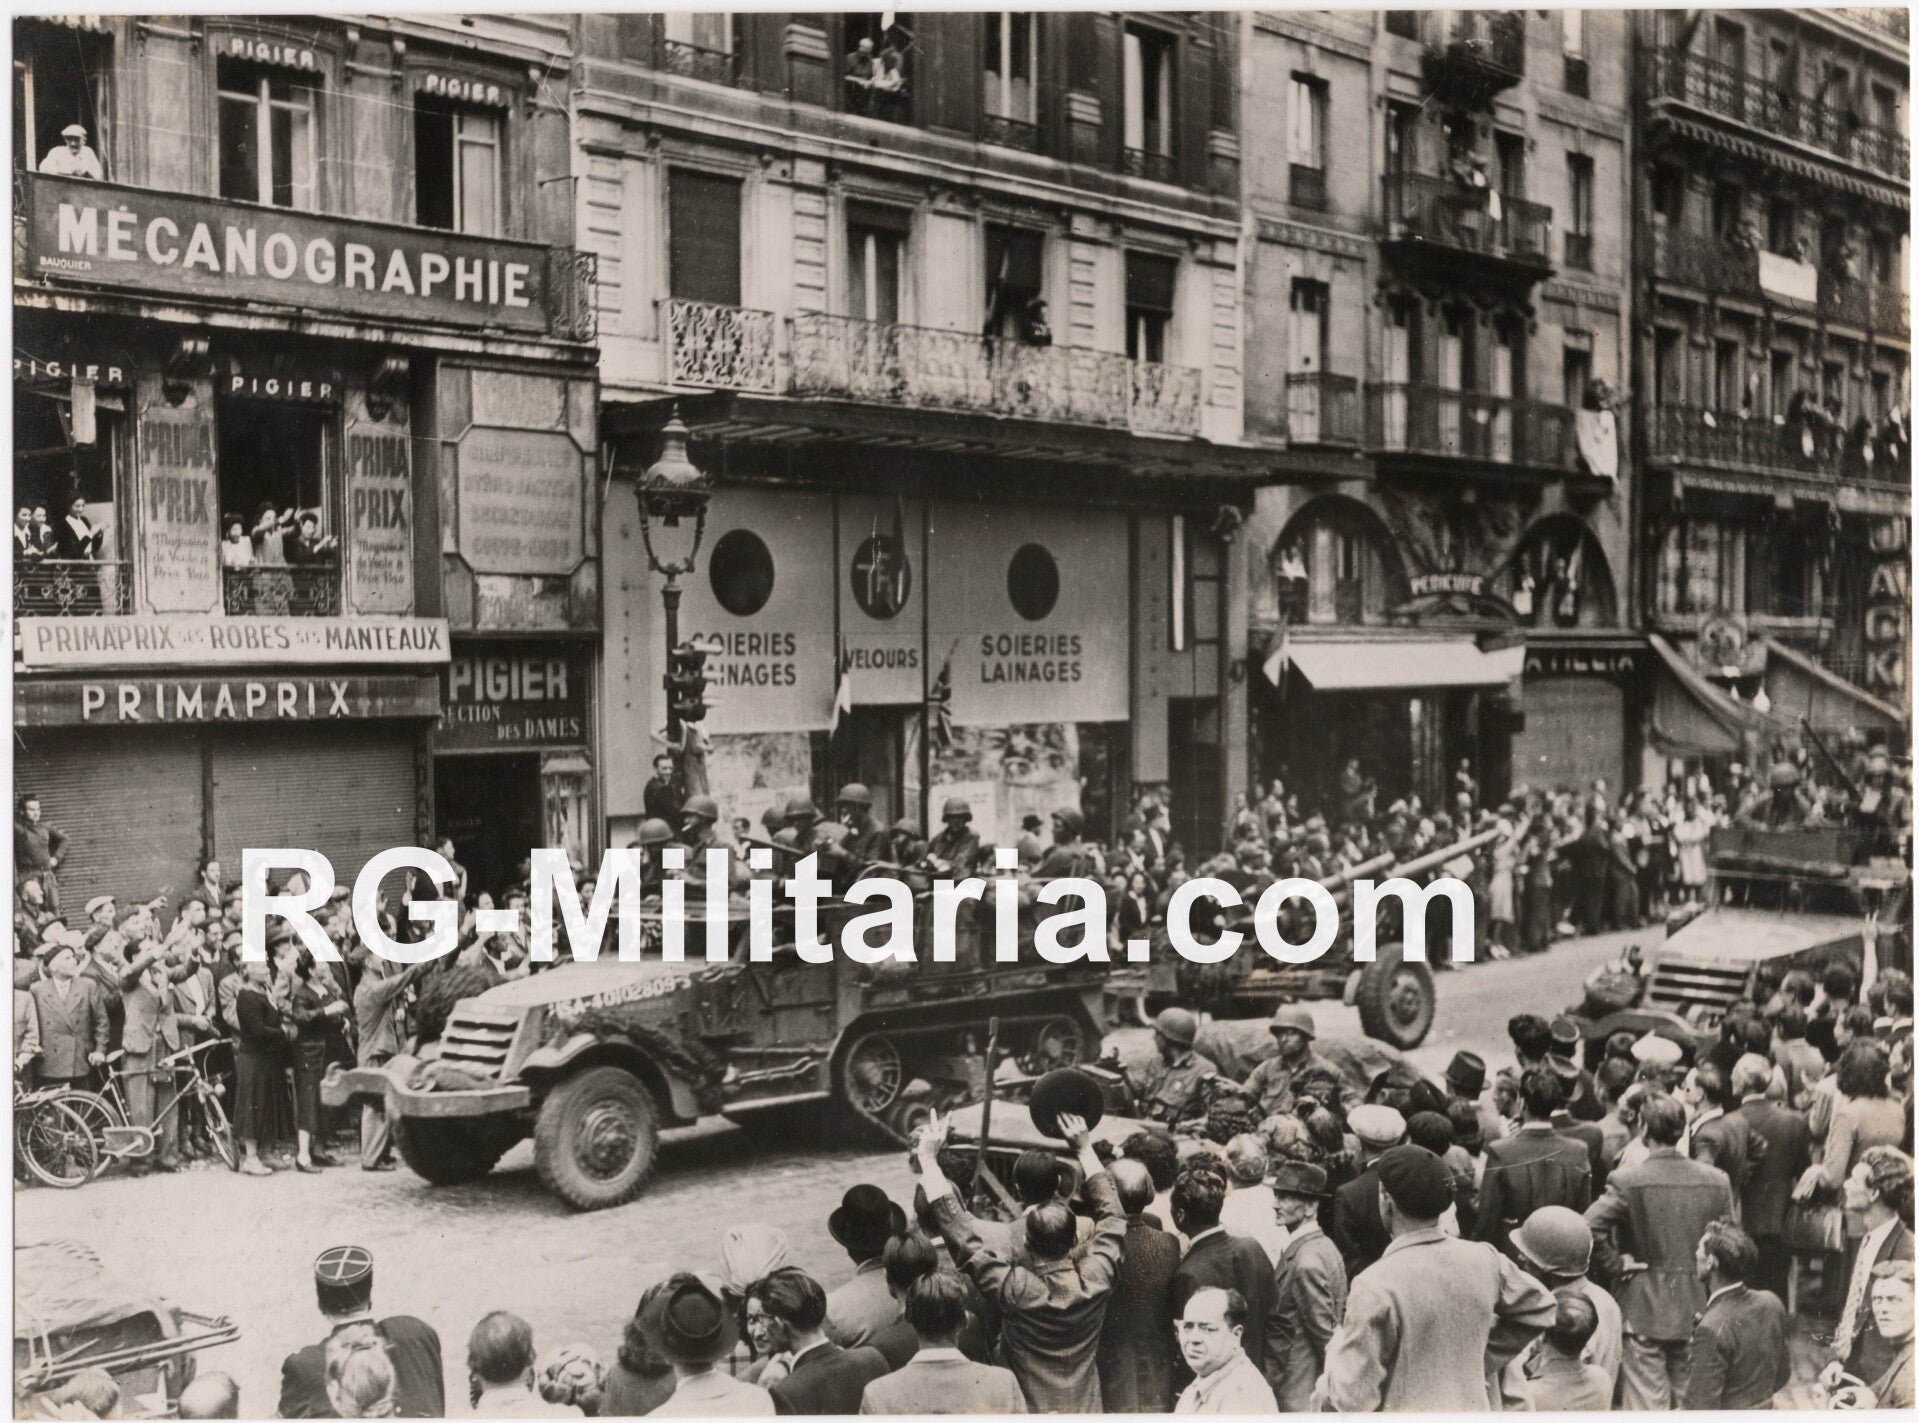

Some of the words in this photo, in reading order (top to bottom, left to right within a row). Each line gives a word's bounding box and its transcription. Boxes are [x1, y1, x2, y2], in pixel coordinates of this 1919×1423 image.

[231, 37, 315, 68] PIGIER
[426, 73, 501, 106] PIGIER
[39, 256, 92, 271] BAUQUIER
[58, 203, 530, 308] MÉCANOGRAPHIE
[231, 376, 332, 399] PIGIER
[144, 420, 214, 470] PRIMA
[350, 435, 409, 479] PRIMA
[150, 477, 209, 525] PRIX
[354, 488, 408, 530] PRIX
[36, 624, 175, 652] PRIMAPRIX
[209, 624, 290, 650] ROBES
[324, 626, 442, 651] MANTEAUX
[980, 634, 1083, 657] SOIERIES
[706, 662, 797, 687] AINAGES
[846, 648, 919, 670] VELOURS
[980, 661, 1083, 684] LAINAGES
[449, 658, 569, 702] PIGIER
[82, 680, 351, 720] PRIMAPRIX
[496, 724, 521, 741] DES
[524, 716, 580, 740] DAMES
